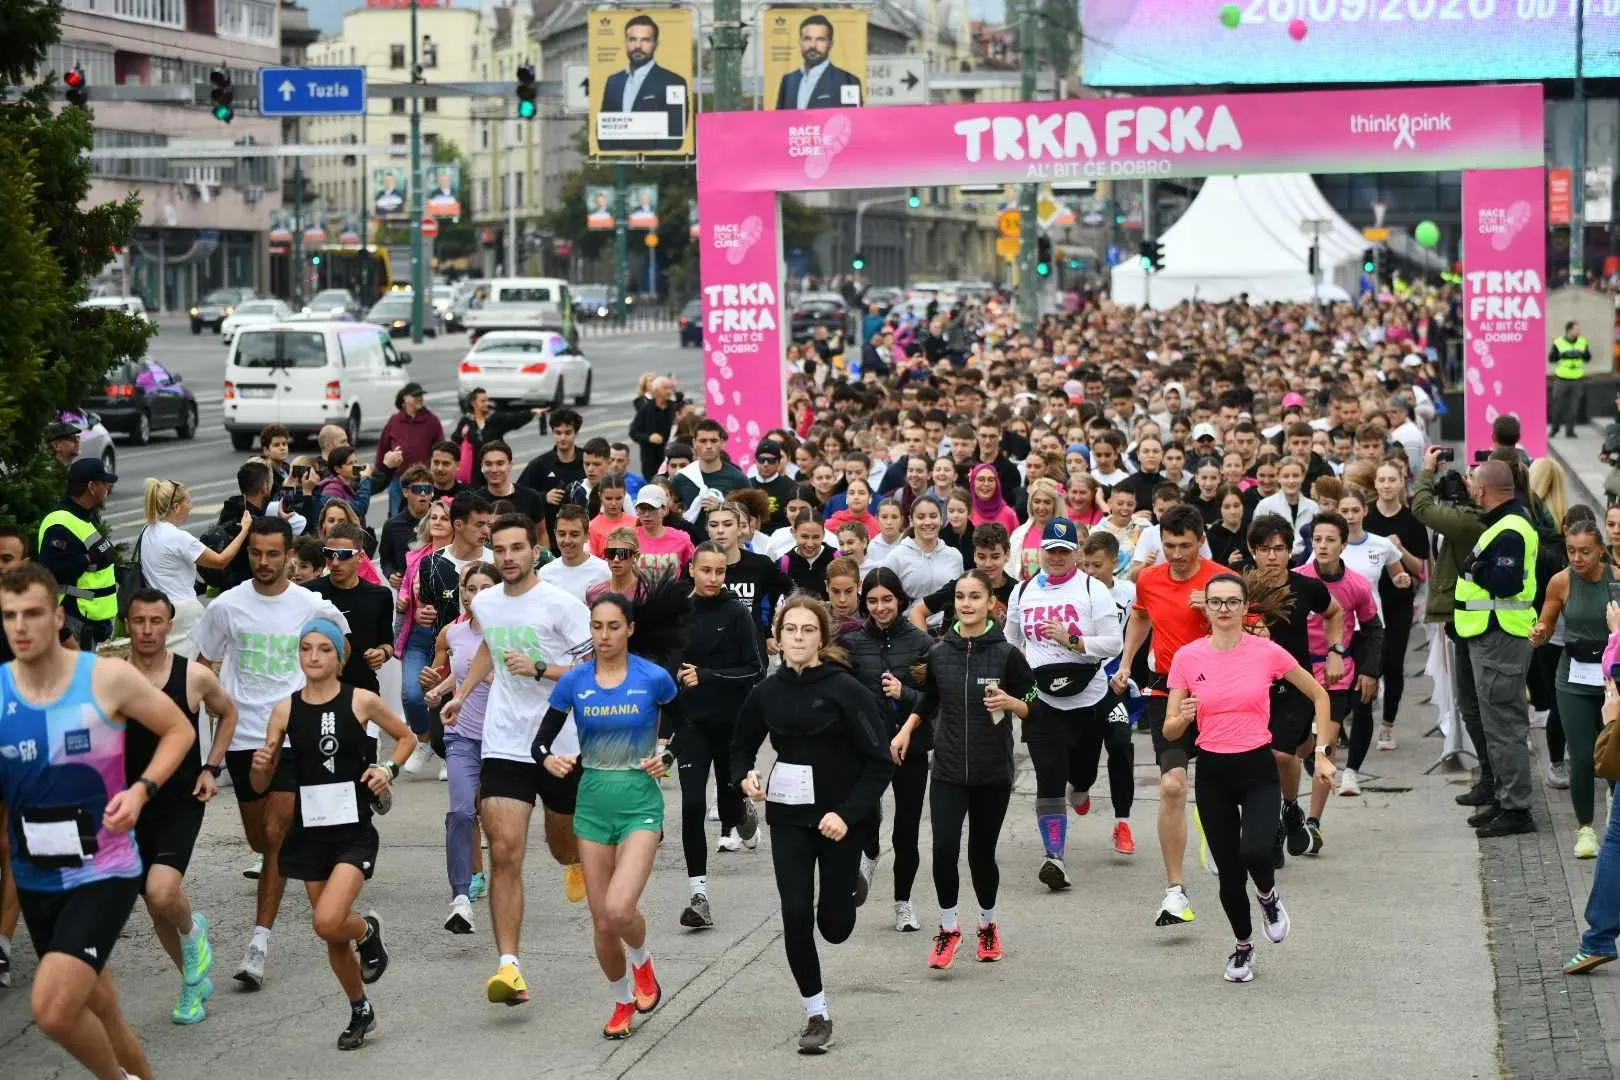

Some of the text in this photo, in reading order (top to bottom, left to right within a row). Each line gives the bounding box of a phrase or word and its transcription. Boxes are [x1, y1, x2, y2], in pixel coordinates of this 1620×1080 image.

[307, 82, 349, 98] Tuzla
[788, 125, 820, 136] RACE
[1350, 112, 1452, 136] think pink
[788, 135, 833, 146] FOR THE
[954, 104, 1243, 162] TRKA FRKA
[1054, 162, 1080, 177] BIT
[1112, 159, 1171, 175] DOBRO
[1479, 208, 1505, 217] RACE
[714, 224, 738, 233] RACE
[1466, 268, 1541, 294] TRKA
[704, 281, 775, 307] TRKA
[1470, 295, 1541, 320] FRKA
[708, 308, 776, 333] FRKA
[1485, 332, 1523, 342] DOBRO
[723, 343, 759, 353] DOBRO
[1023, 603, 1080, 623] TRKA
[583, 703, 639, 717] ROMANIA
